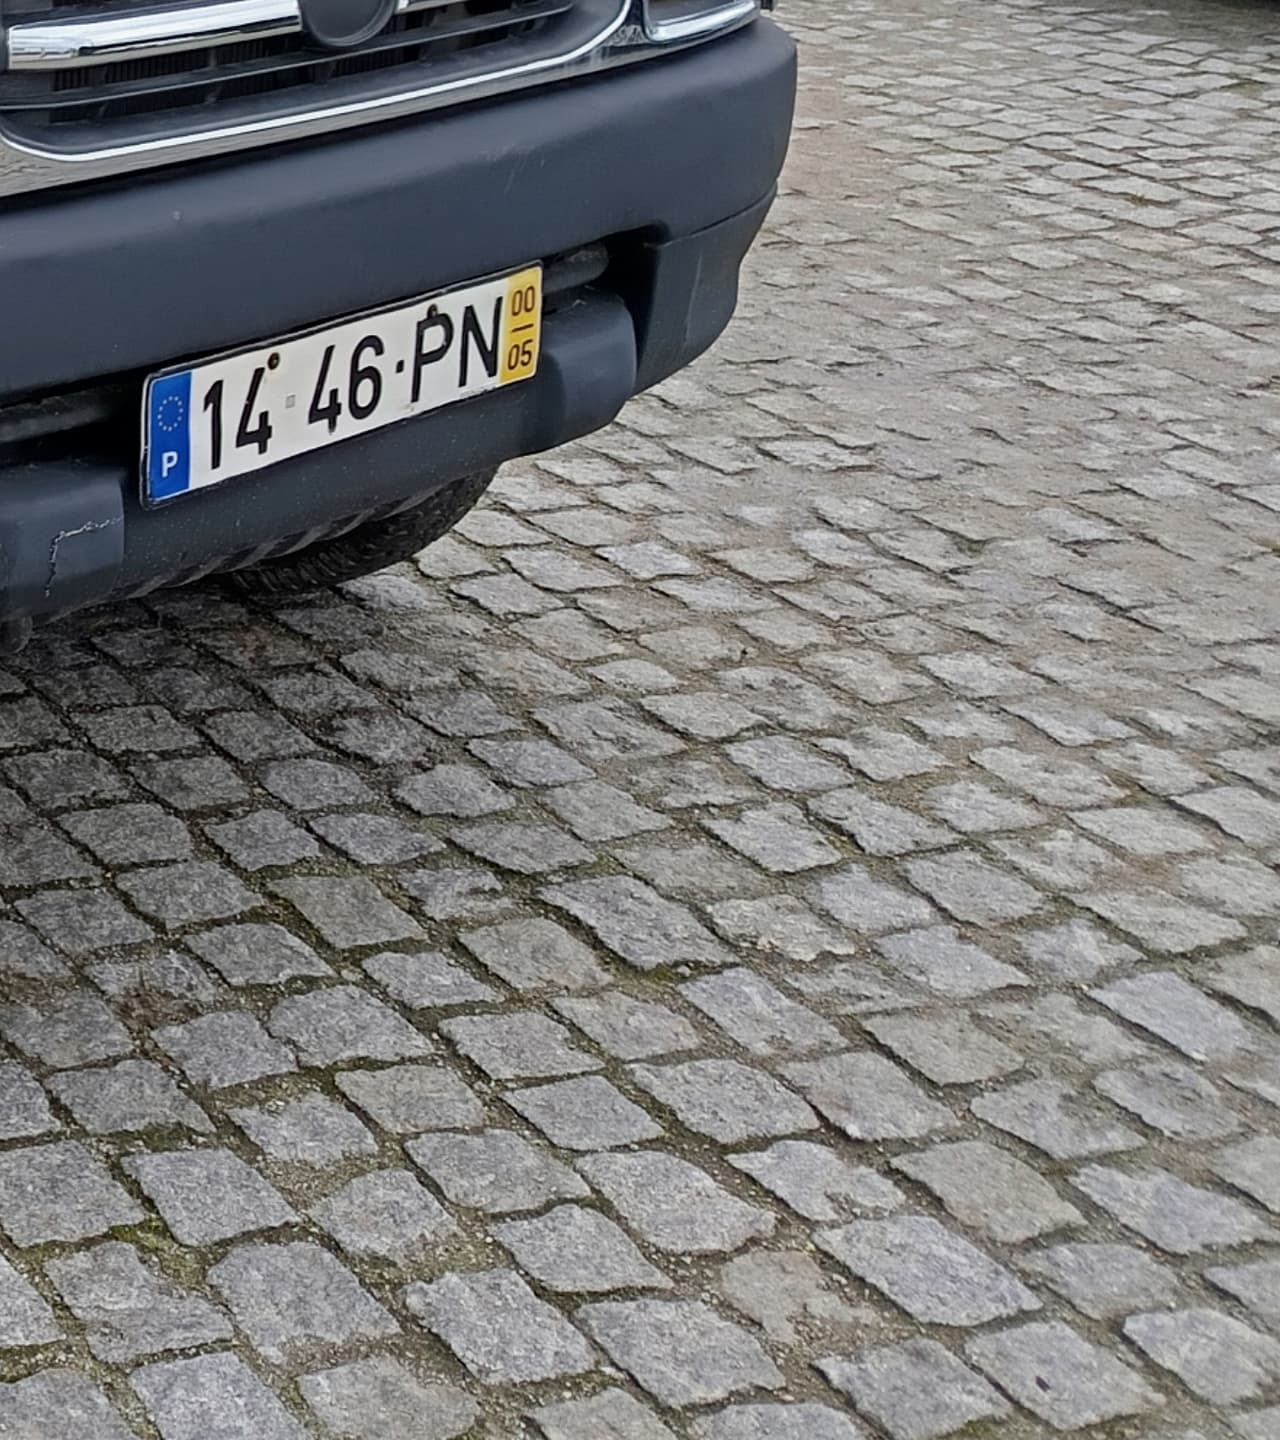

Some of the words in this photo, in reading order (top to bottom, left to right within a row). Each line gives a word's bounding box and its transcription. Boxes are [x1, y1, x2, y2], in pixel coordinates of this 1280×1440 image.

[511, 285, 536, 317] 00
[507, 339, 534, 371] 05
[161, 450, 179, 478] P
